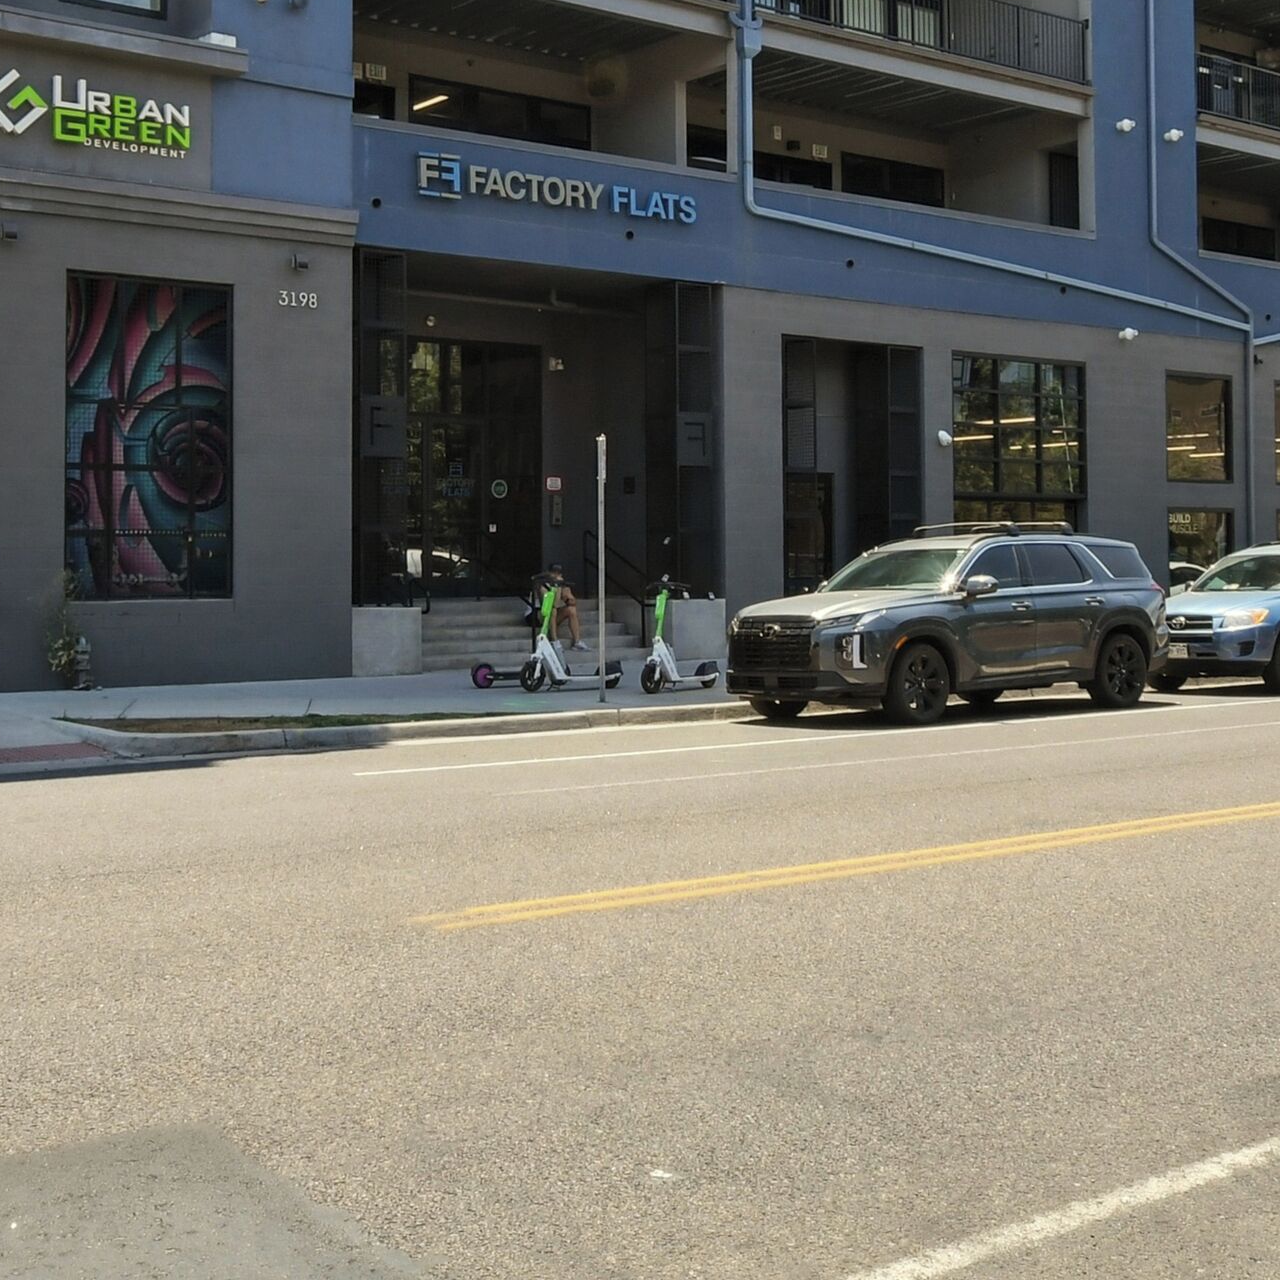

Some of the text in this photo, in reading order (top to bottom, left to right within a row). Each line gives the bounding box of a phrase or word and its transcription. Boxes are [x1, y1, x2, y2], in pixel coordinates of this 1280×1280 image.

[52, 75, 190, 127] URBAN
[53, 107, 191, 149] GREEN
[83, 137, 187, 159] DEVELOPMENT
[469, 164, 604, 211] FACTORY
[610, 184, 697, 224] FLATS
[278, 290, 318, 309] 3198
